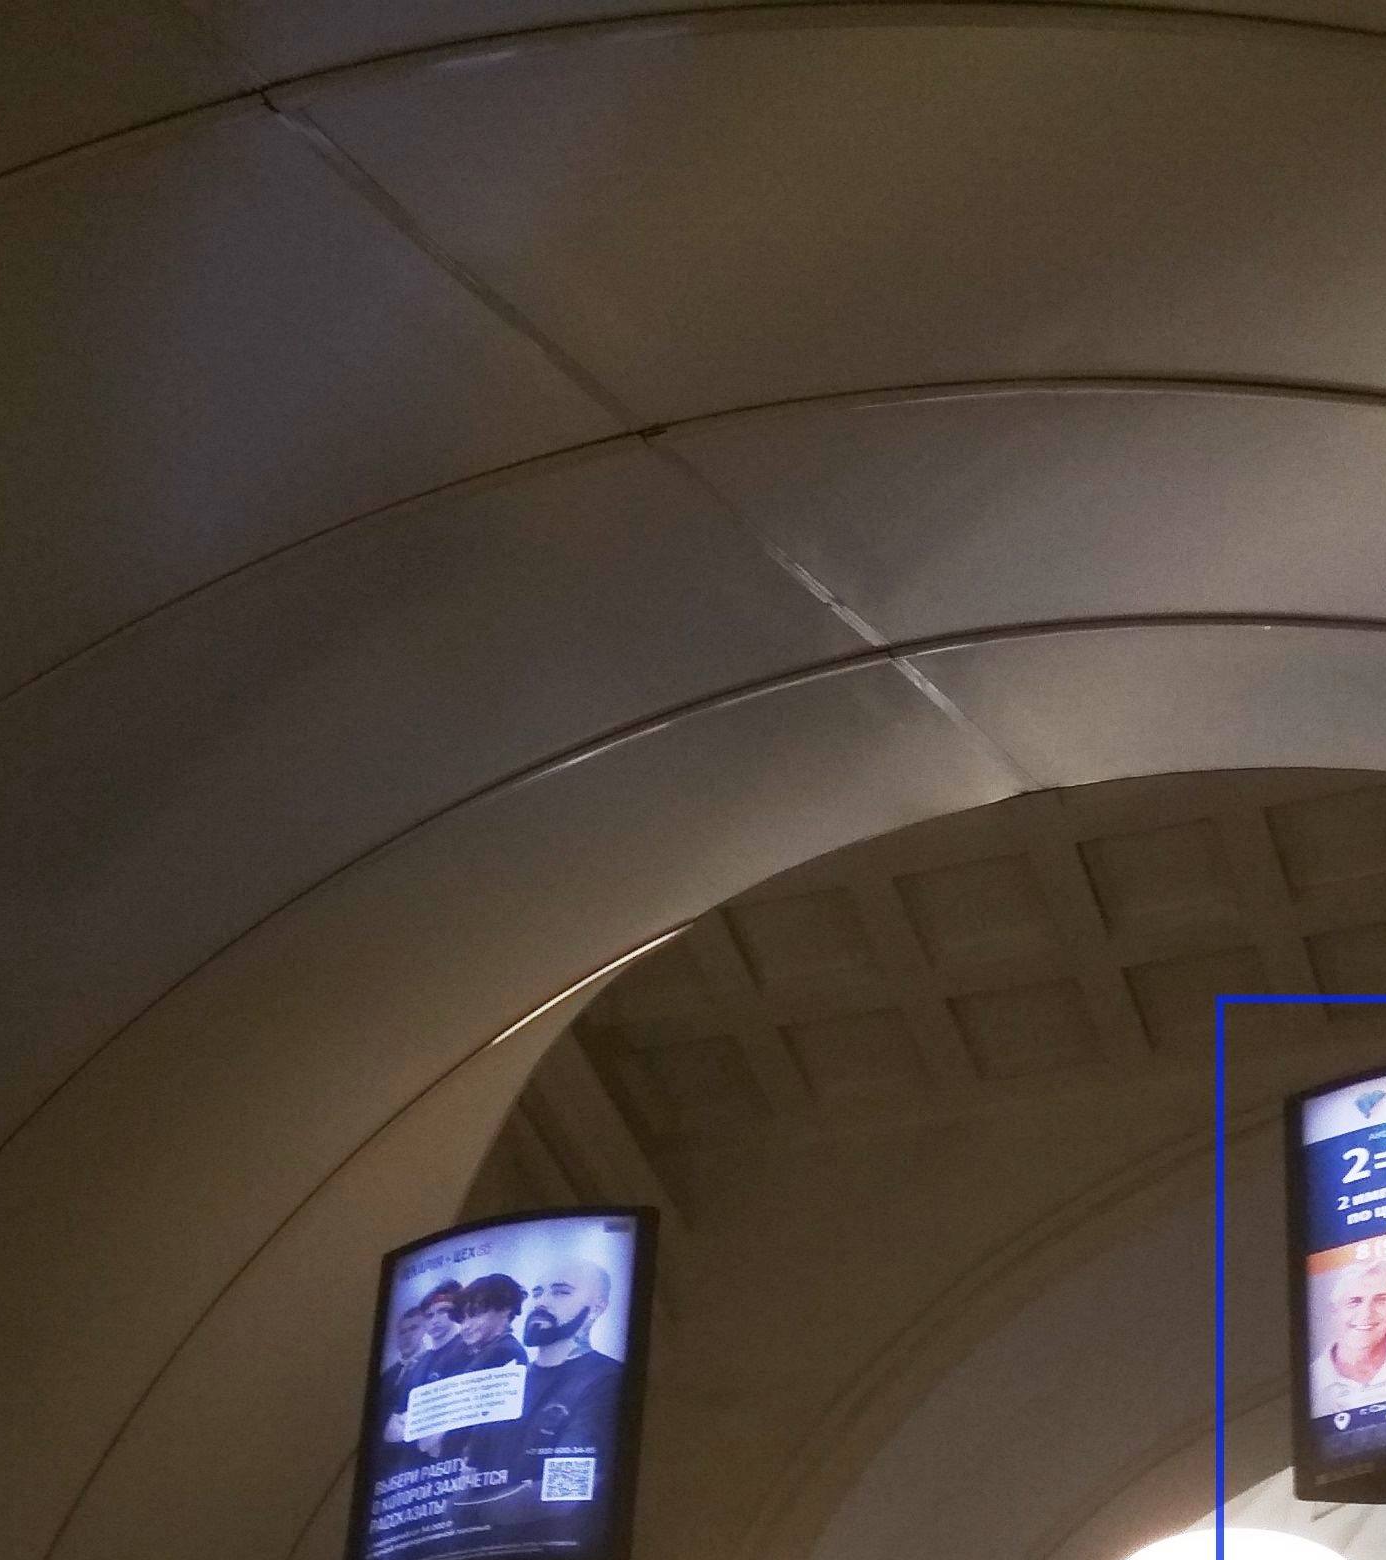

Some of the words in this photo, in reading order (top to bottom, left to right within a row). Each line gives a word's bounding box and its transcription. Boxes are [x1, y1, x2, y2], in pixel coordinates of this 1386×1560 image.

[1336, 1195, 1351, 1211] 2
[1346, 1209, 1373, 1225] по
[1354, 1242, 1371, 1260] 8
